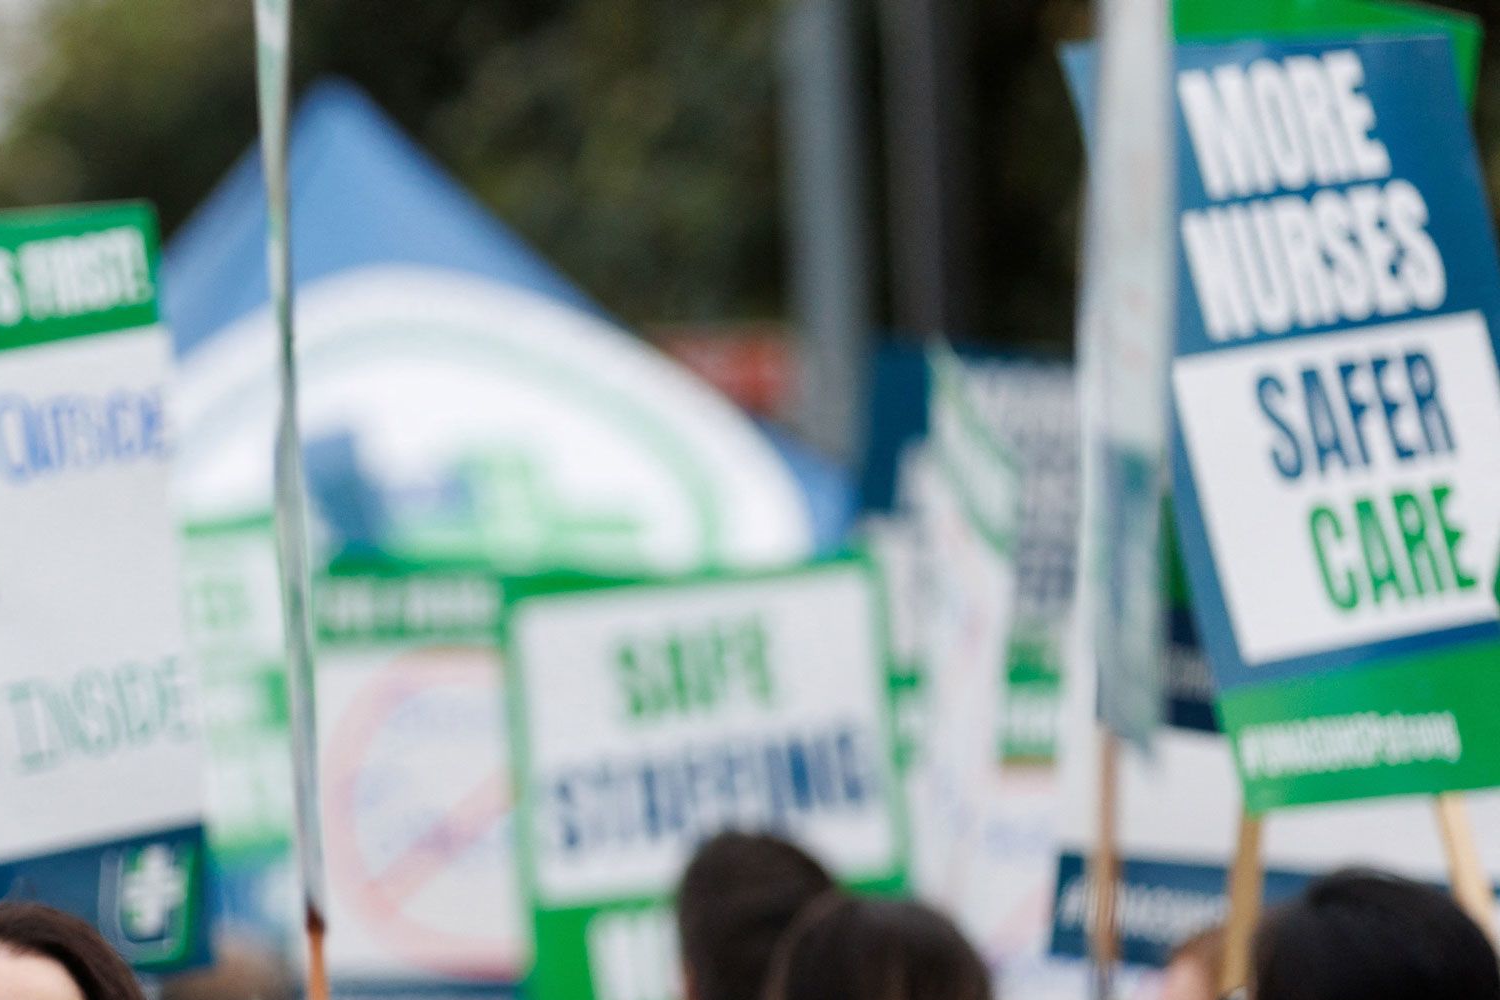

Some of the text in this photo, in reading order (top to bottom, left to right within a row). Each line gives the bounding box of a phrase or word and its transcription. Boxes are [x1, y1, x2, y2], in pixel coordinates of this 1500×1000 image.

[1177, 50, 1392, 201] MORE
[1182, 178, 1447, 341] NURSES
[1255, 351, 1458, 482] SAFER
[1308, 485, 1479, 612] CARE
